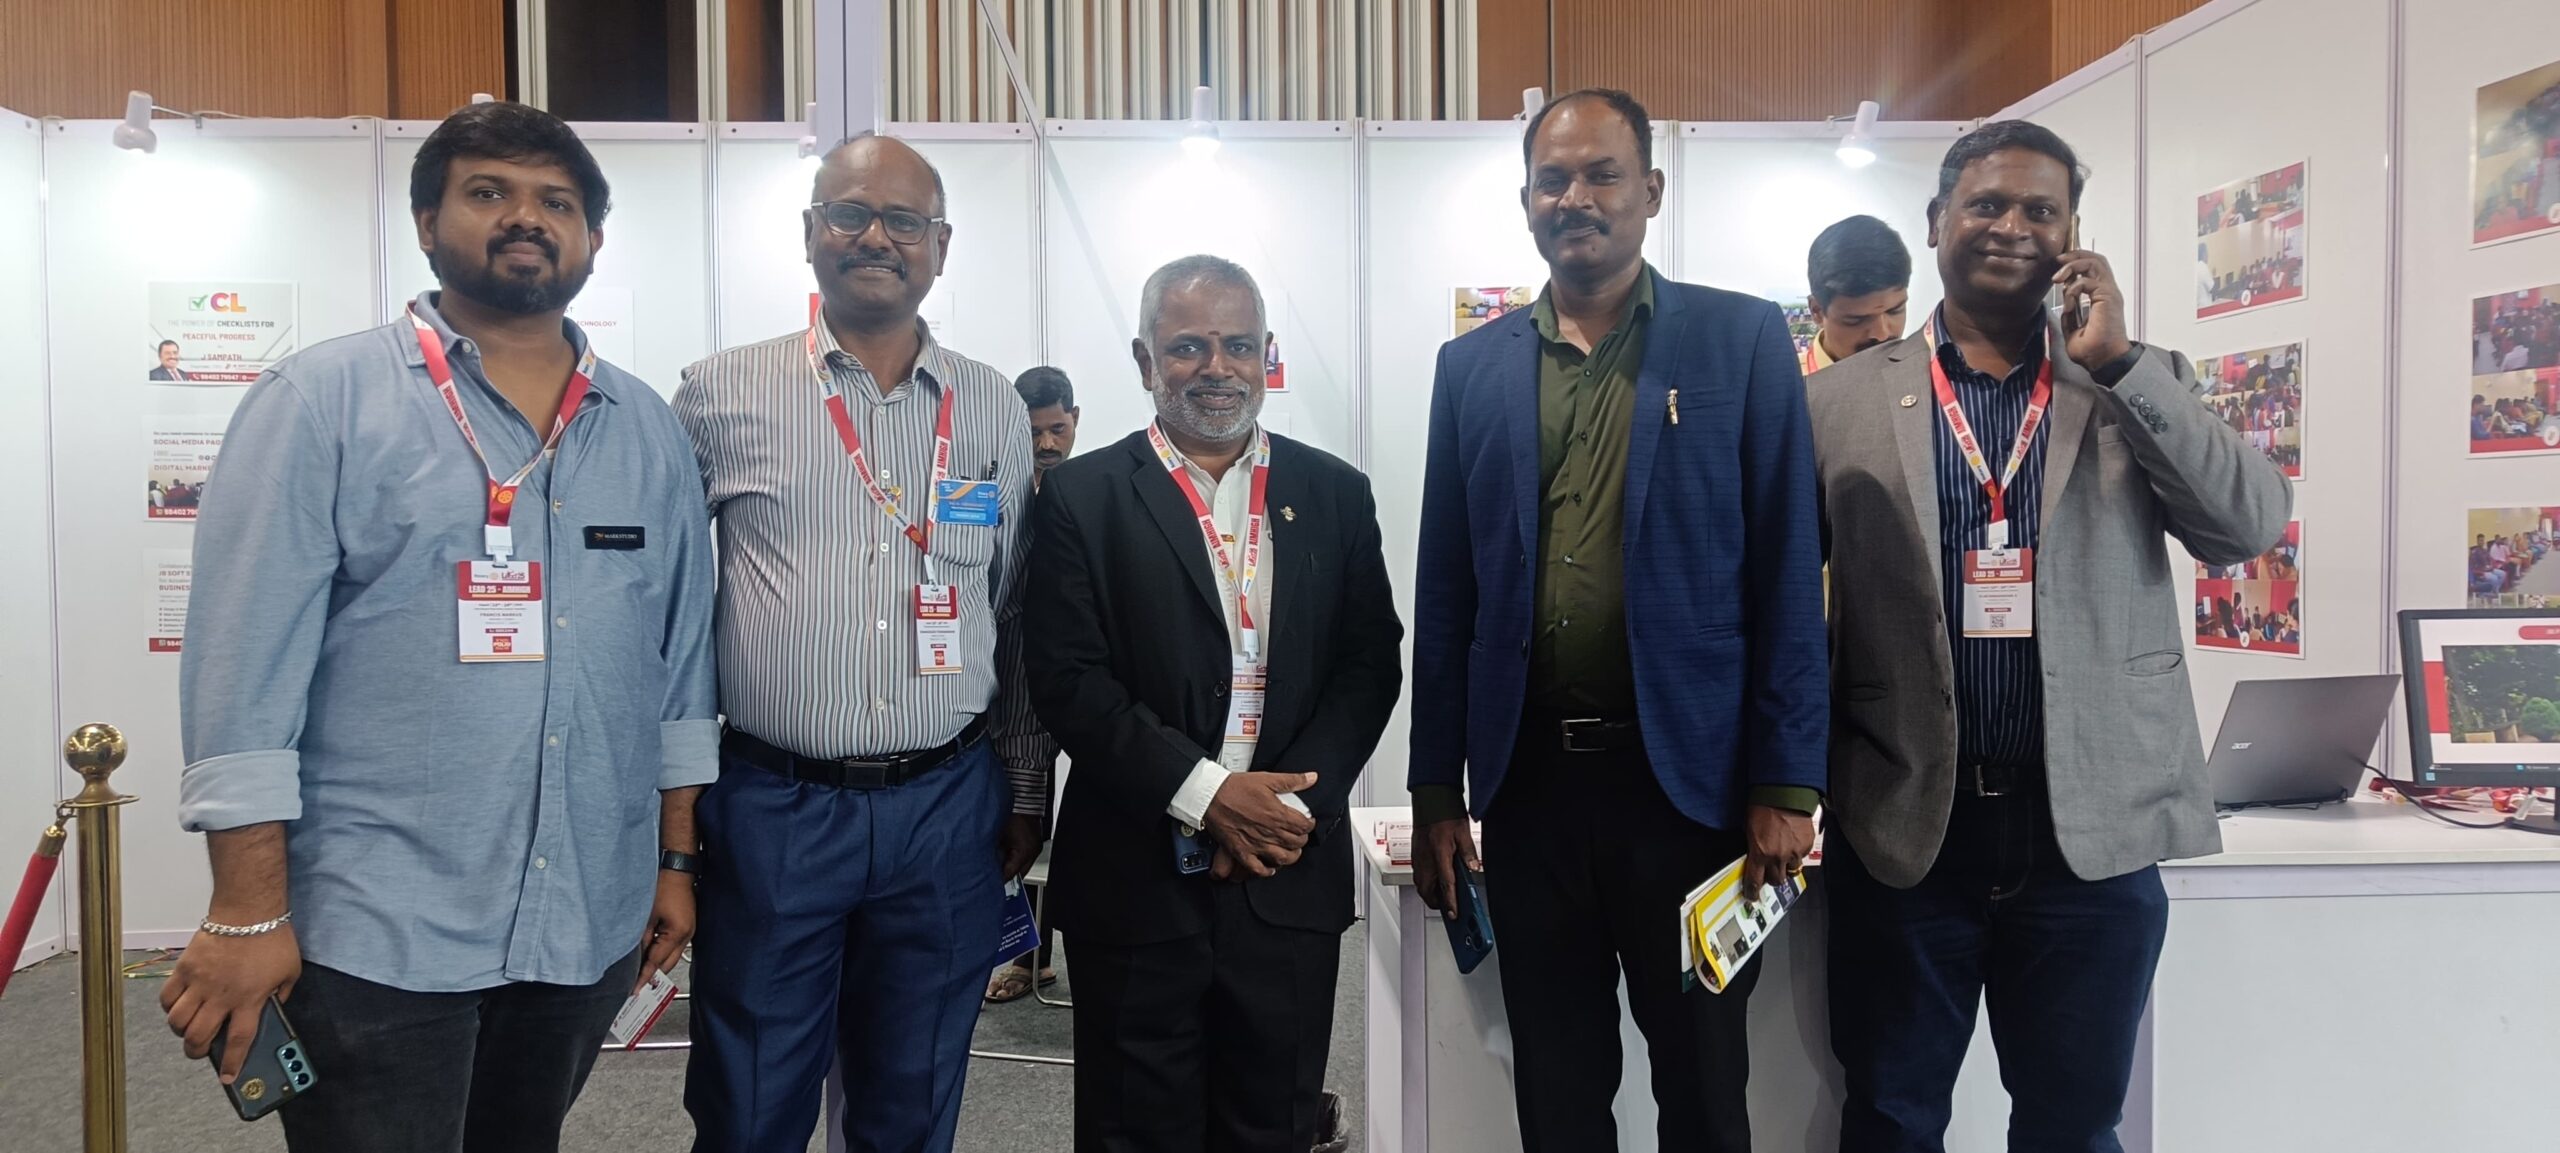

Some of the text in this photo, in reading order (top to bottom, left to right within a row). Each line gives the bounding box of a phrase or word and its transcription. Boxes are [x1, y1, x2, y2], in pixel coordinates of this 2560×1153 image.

[210, 292, 247, 313] CL
[217, 320, 260, 328] CHECKLISTS
[183, 333, 256, 341] PEACEFUL PROGRESS
[207, 353, 242, 361] SAMPATH
[2231, 742, 2253, 750] acer
